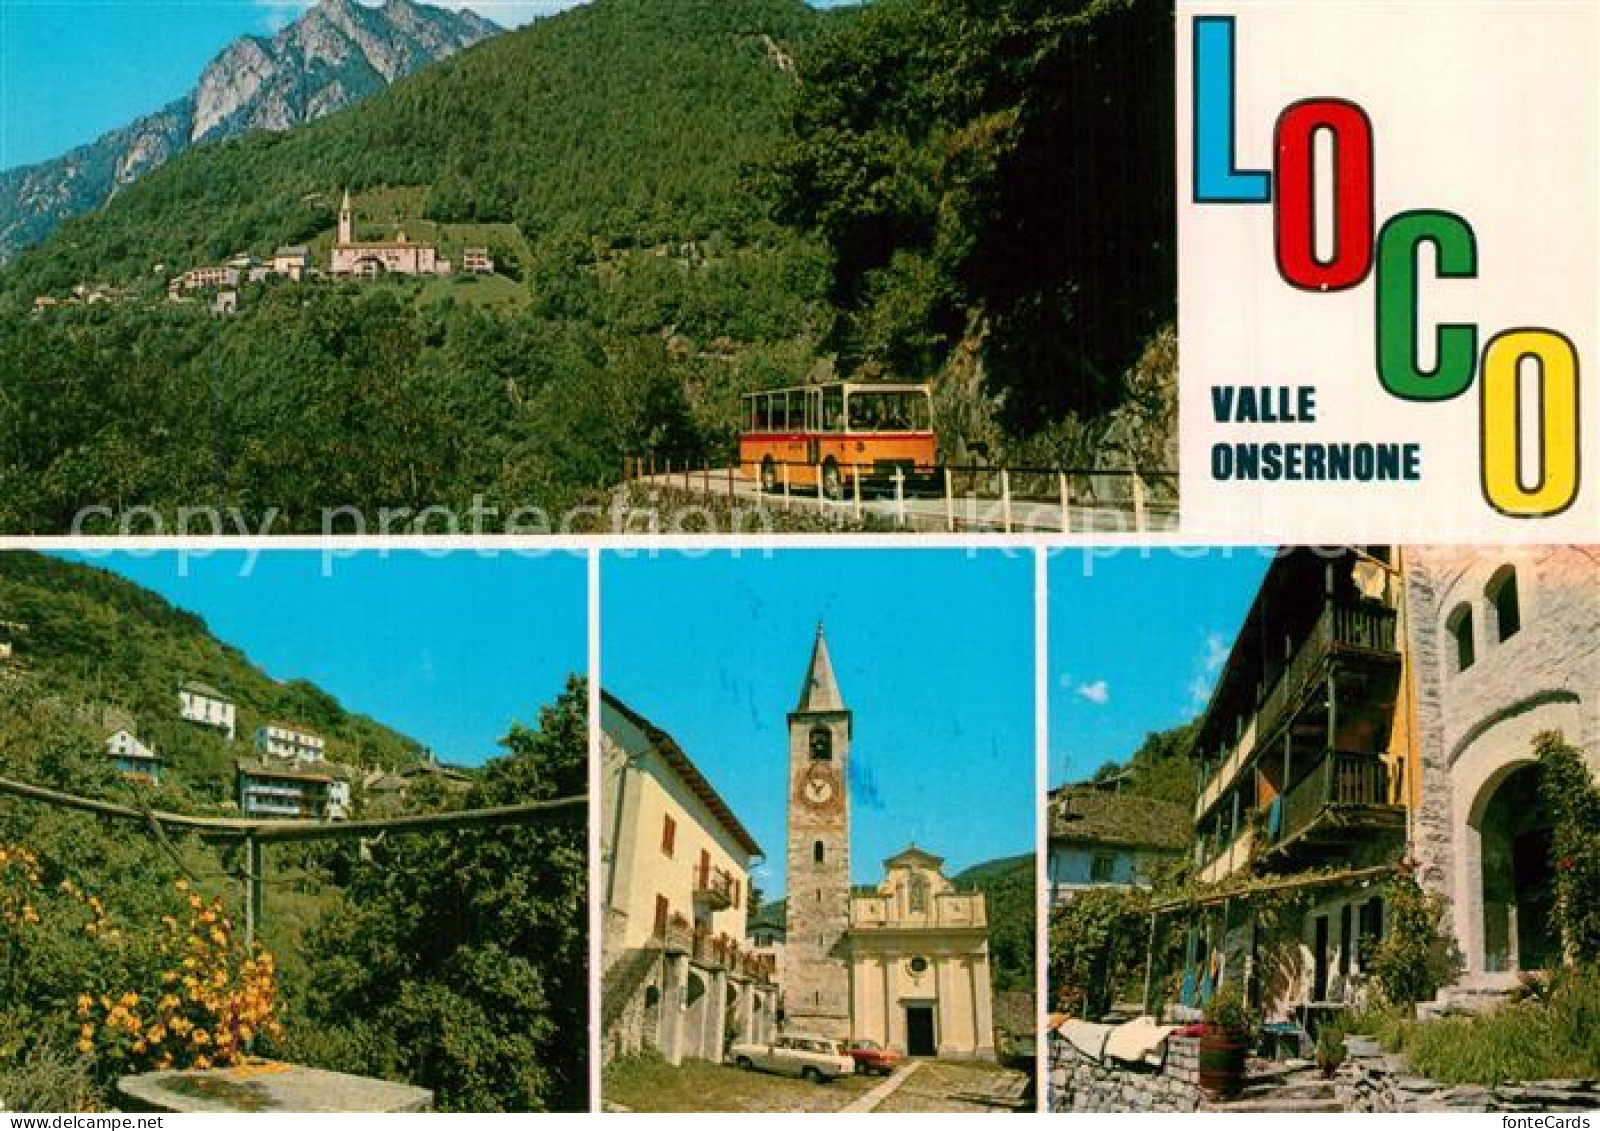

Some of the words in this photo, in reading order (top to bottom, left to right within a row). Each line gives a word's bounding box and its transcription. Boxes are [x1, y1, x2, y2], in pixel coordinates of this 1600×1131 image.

[1191, 15, 1582, 519] LOCO
[1210, 385, 1316, 424] VALLE
[1210, 442, 1421, 482] ONSERNONE
